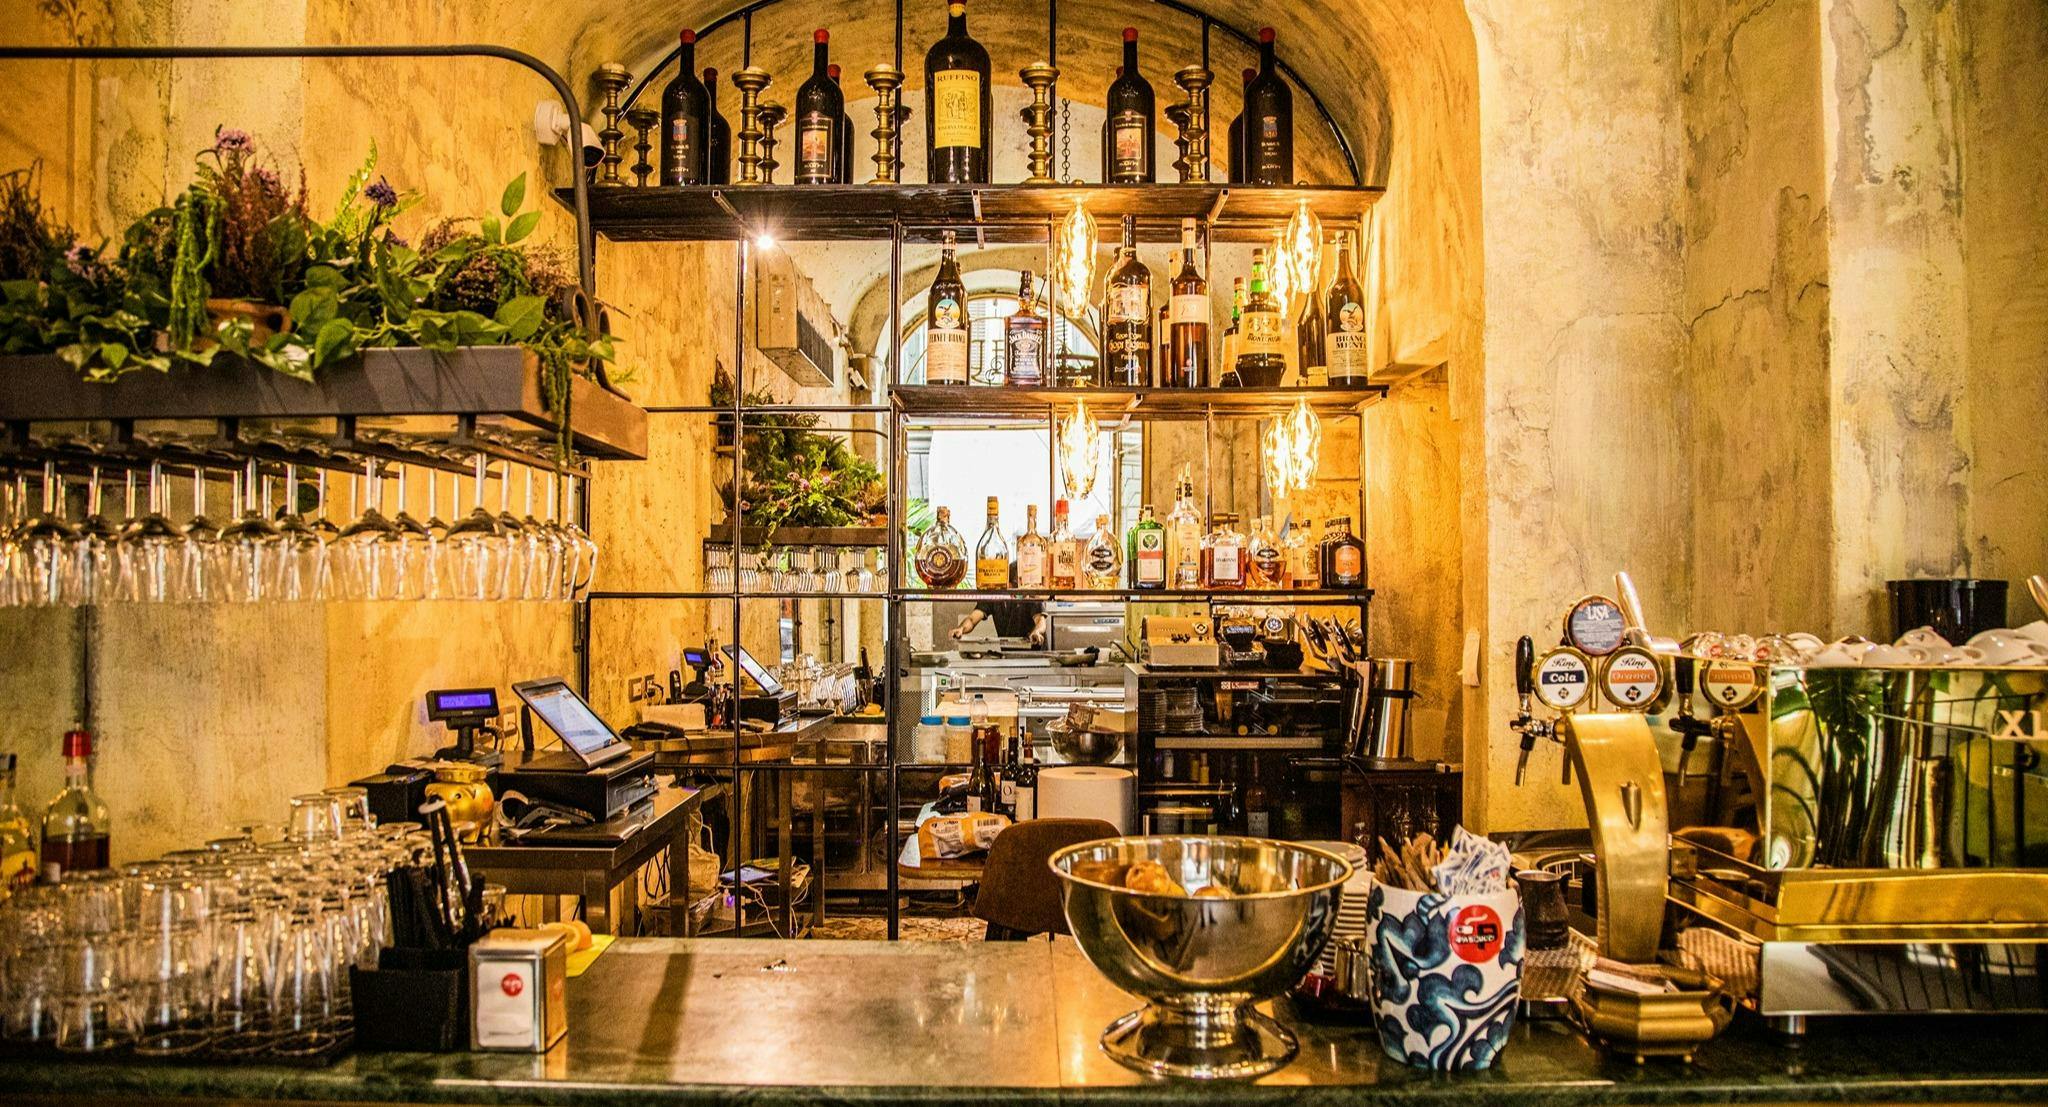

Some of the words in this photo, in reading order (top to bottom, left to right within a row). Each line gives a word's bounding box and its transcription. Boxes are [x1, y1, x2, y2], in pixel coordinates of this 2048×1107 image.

[937, 74, 978, 82] RUFFINO
[1551, 657, 1577, 669] King
[1620, 657, 1647, 669] King
[1549, 673, 1577, 683] Cola
